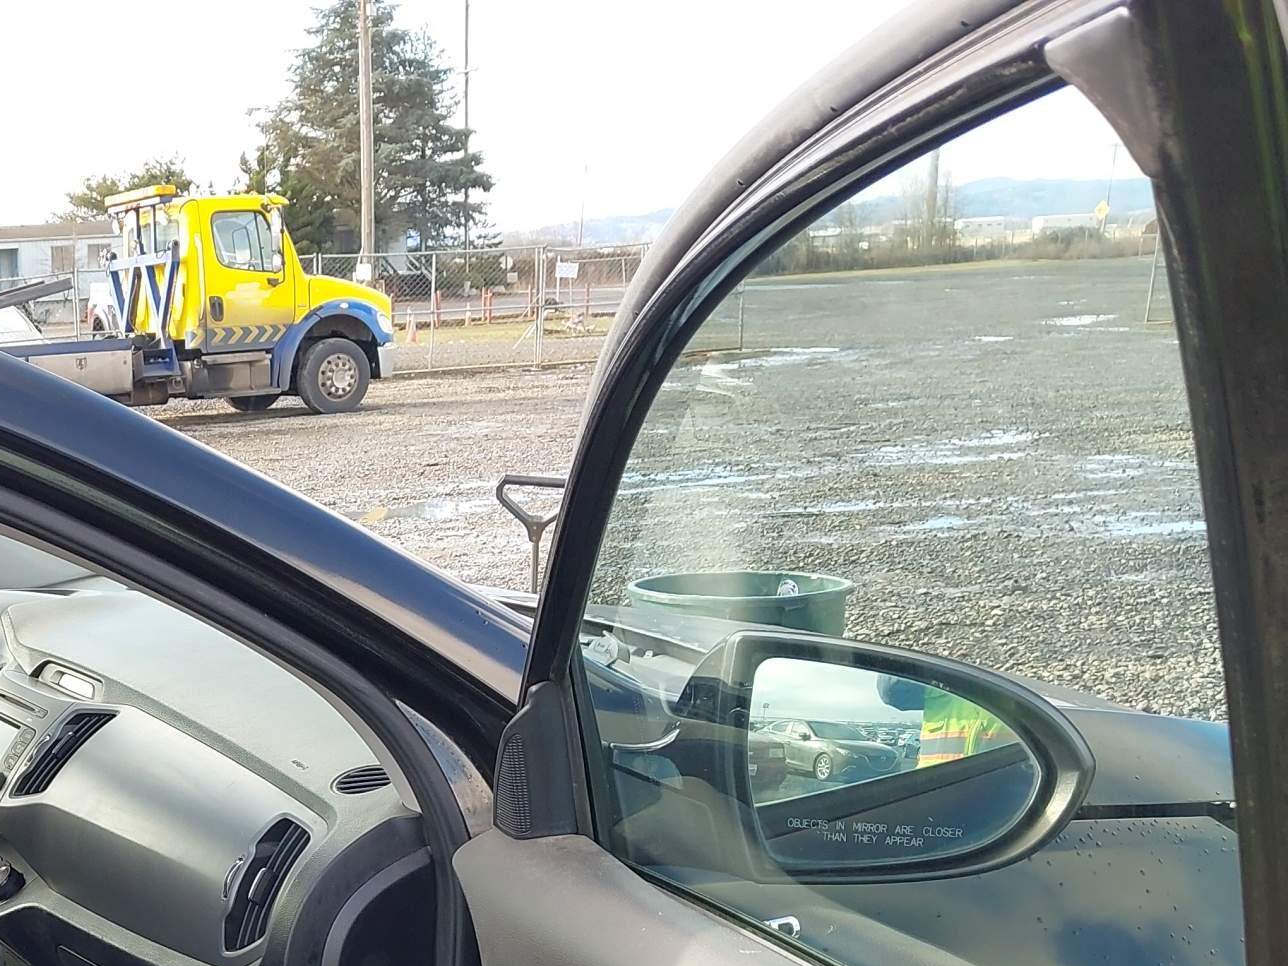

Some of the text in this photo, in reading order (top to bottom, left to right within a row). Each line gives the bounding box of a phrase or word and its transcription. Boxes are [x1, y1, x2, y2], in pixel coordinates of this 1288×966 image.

[787, 817, 963, 838] OBJECTS IN MIRROR ARE CLOSER
[823, 831, 924, 847] THAN THEY APPEAR
